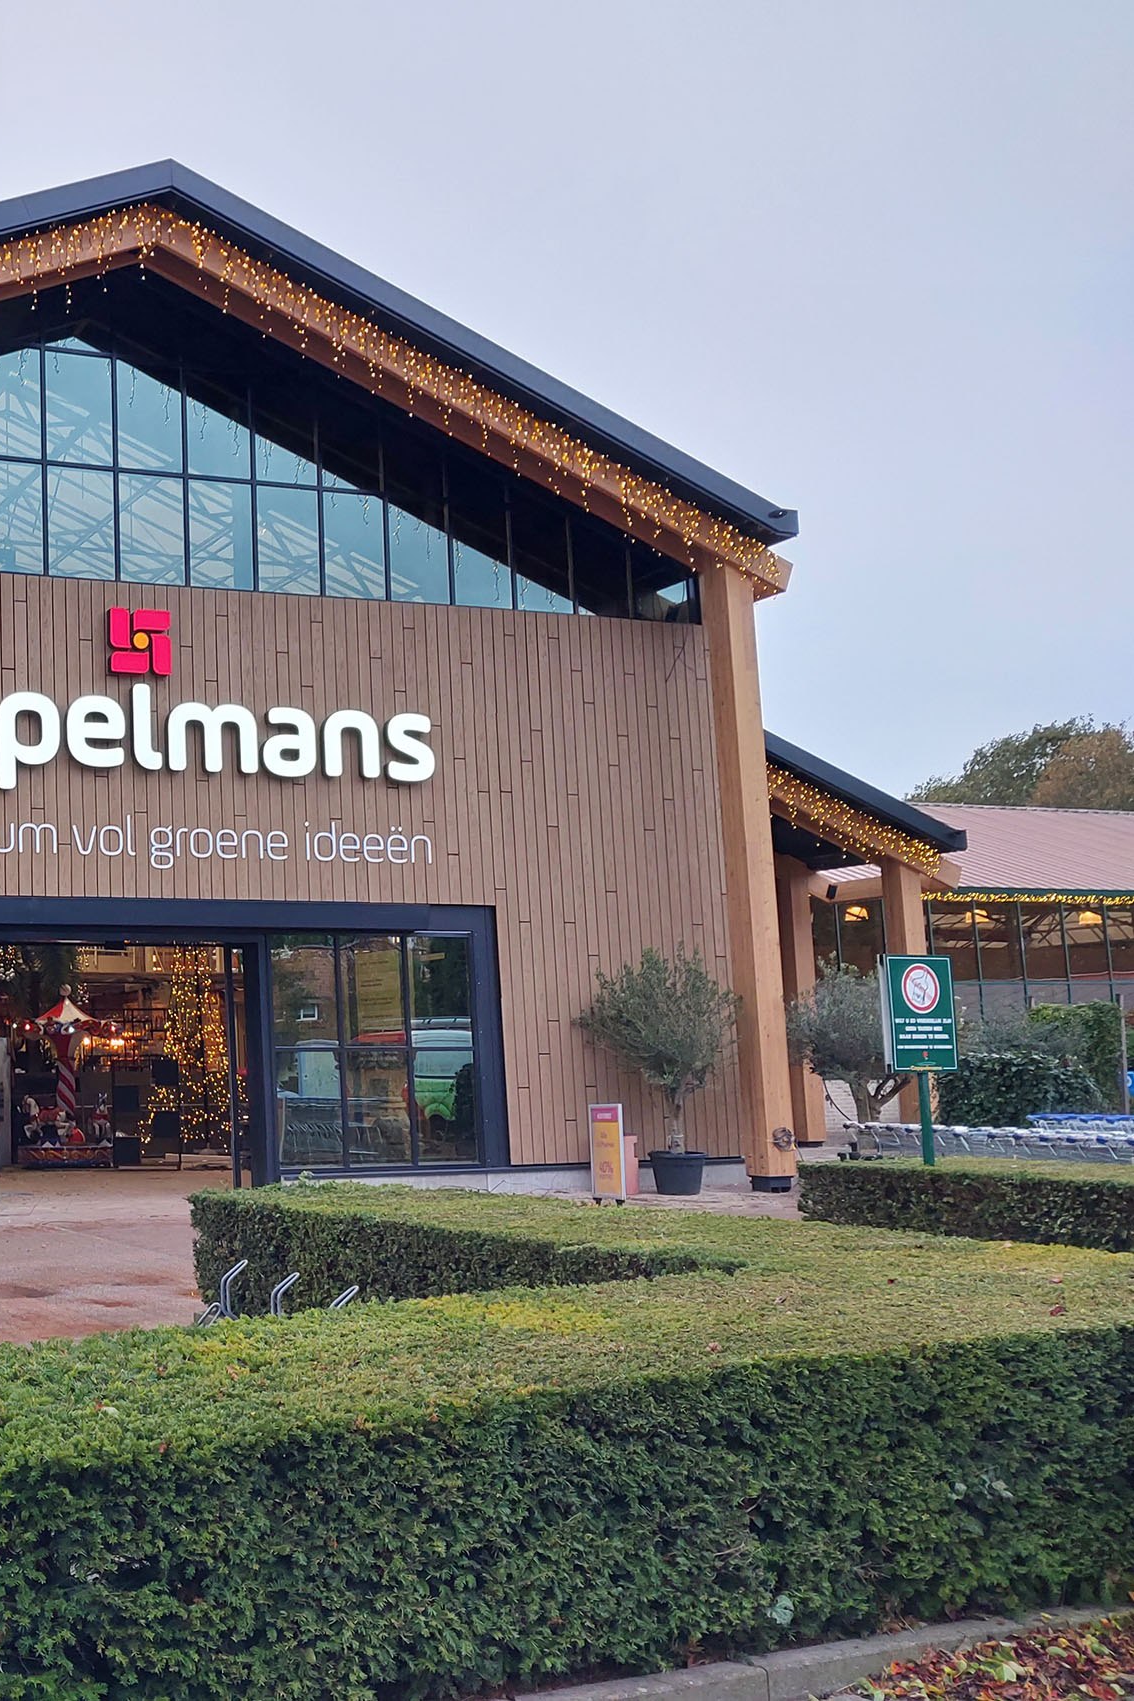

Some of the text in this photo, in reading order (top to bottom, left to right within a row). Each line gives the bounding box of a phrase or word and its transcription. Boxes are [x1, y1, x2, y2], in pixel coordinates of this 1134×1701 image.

[72, 814, 136, 856] vol
[150, 825, 289, 869] groene
[304, 821, 433, 864] ideeën
